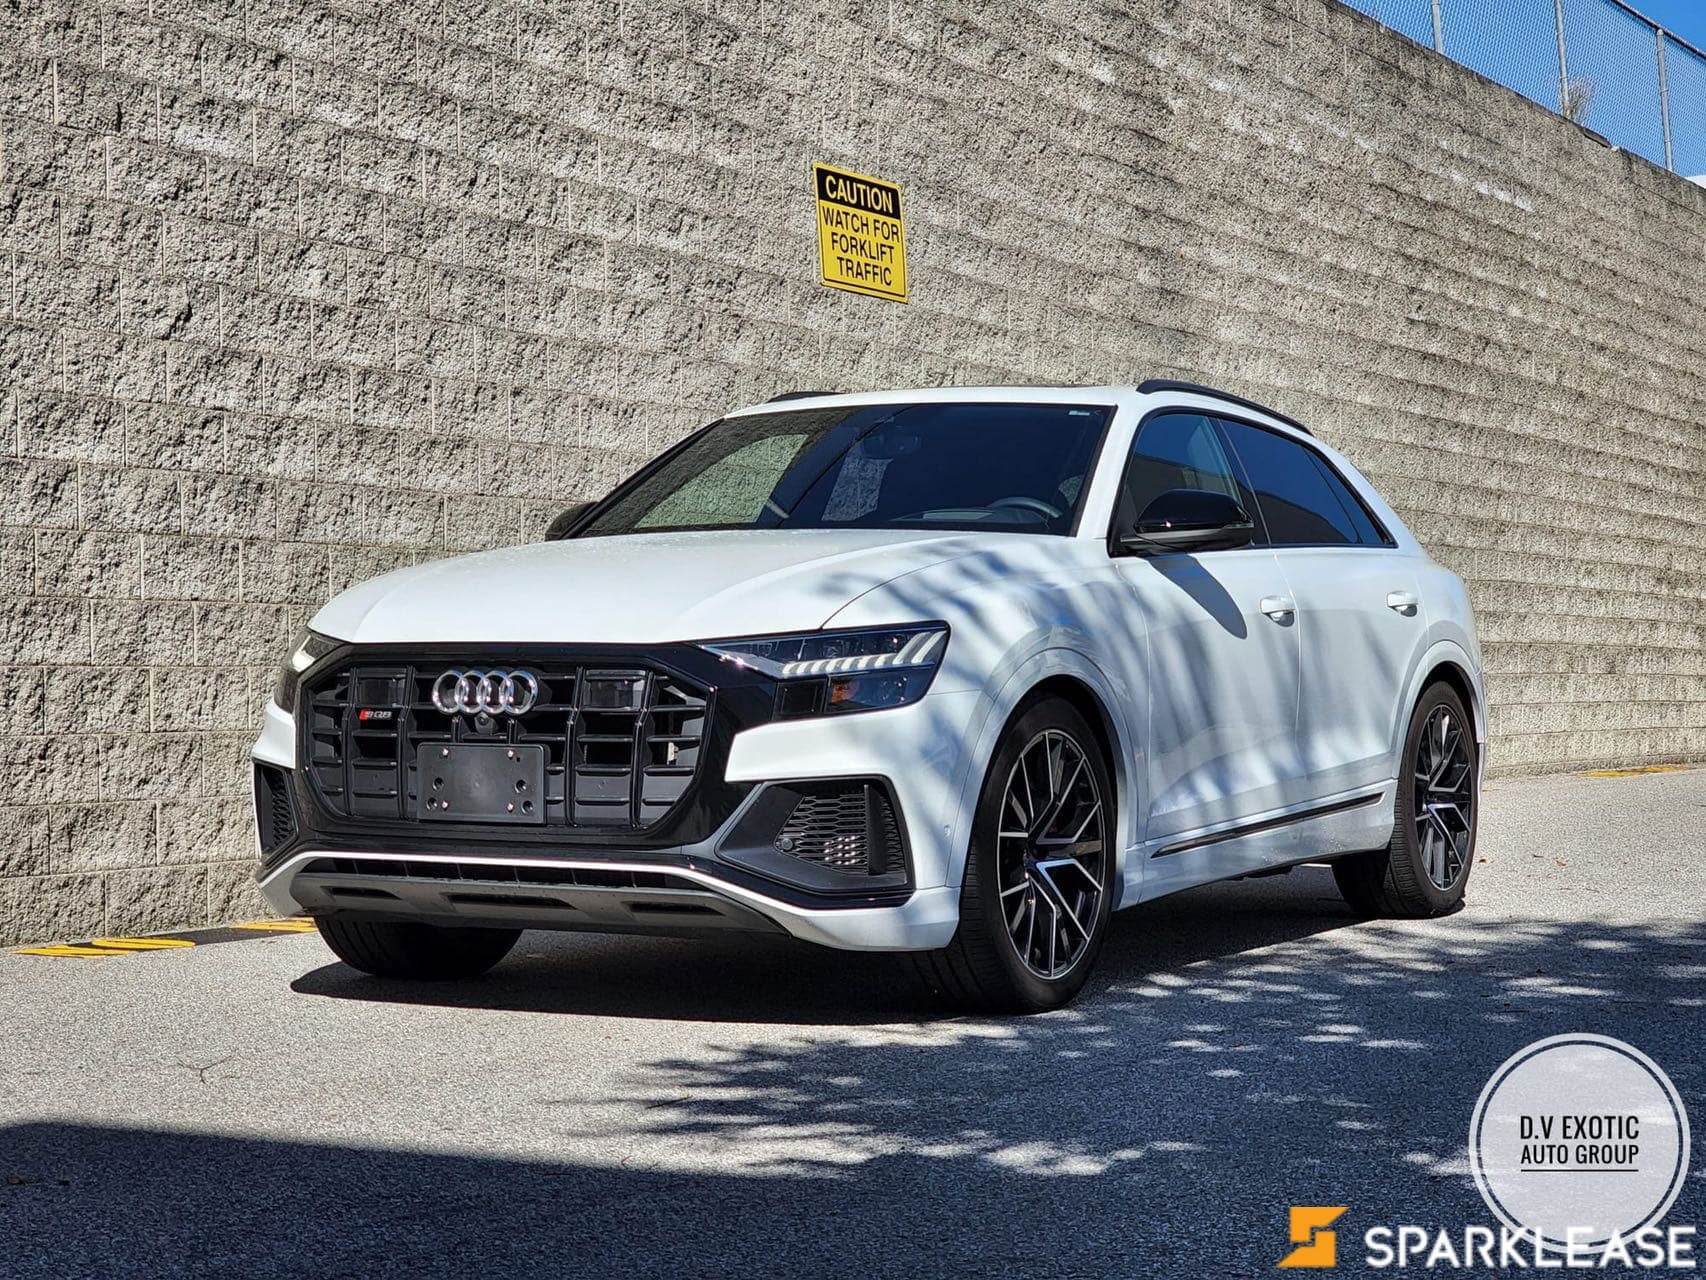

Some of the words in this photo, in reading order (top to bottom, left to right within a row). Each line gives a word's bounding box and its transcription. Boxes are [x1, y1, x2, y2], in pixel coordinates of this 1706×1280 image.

[825, 175, 893, 213] CAUTION
[822, 206, 870, 235] WATCH
[873, 219, 900, 243] FOR
[831, 232, 894, 264] FORKLIFT
[837, 256, 892, 286] TRAFFIC
